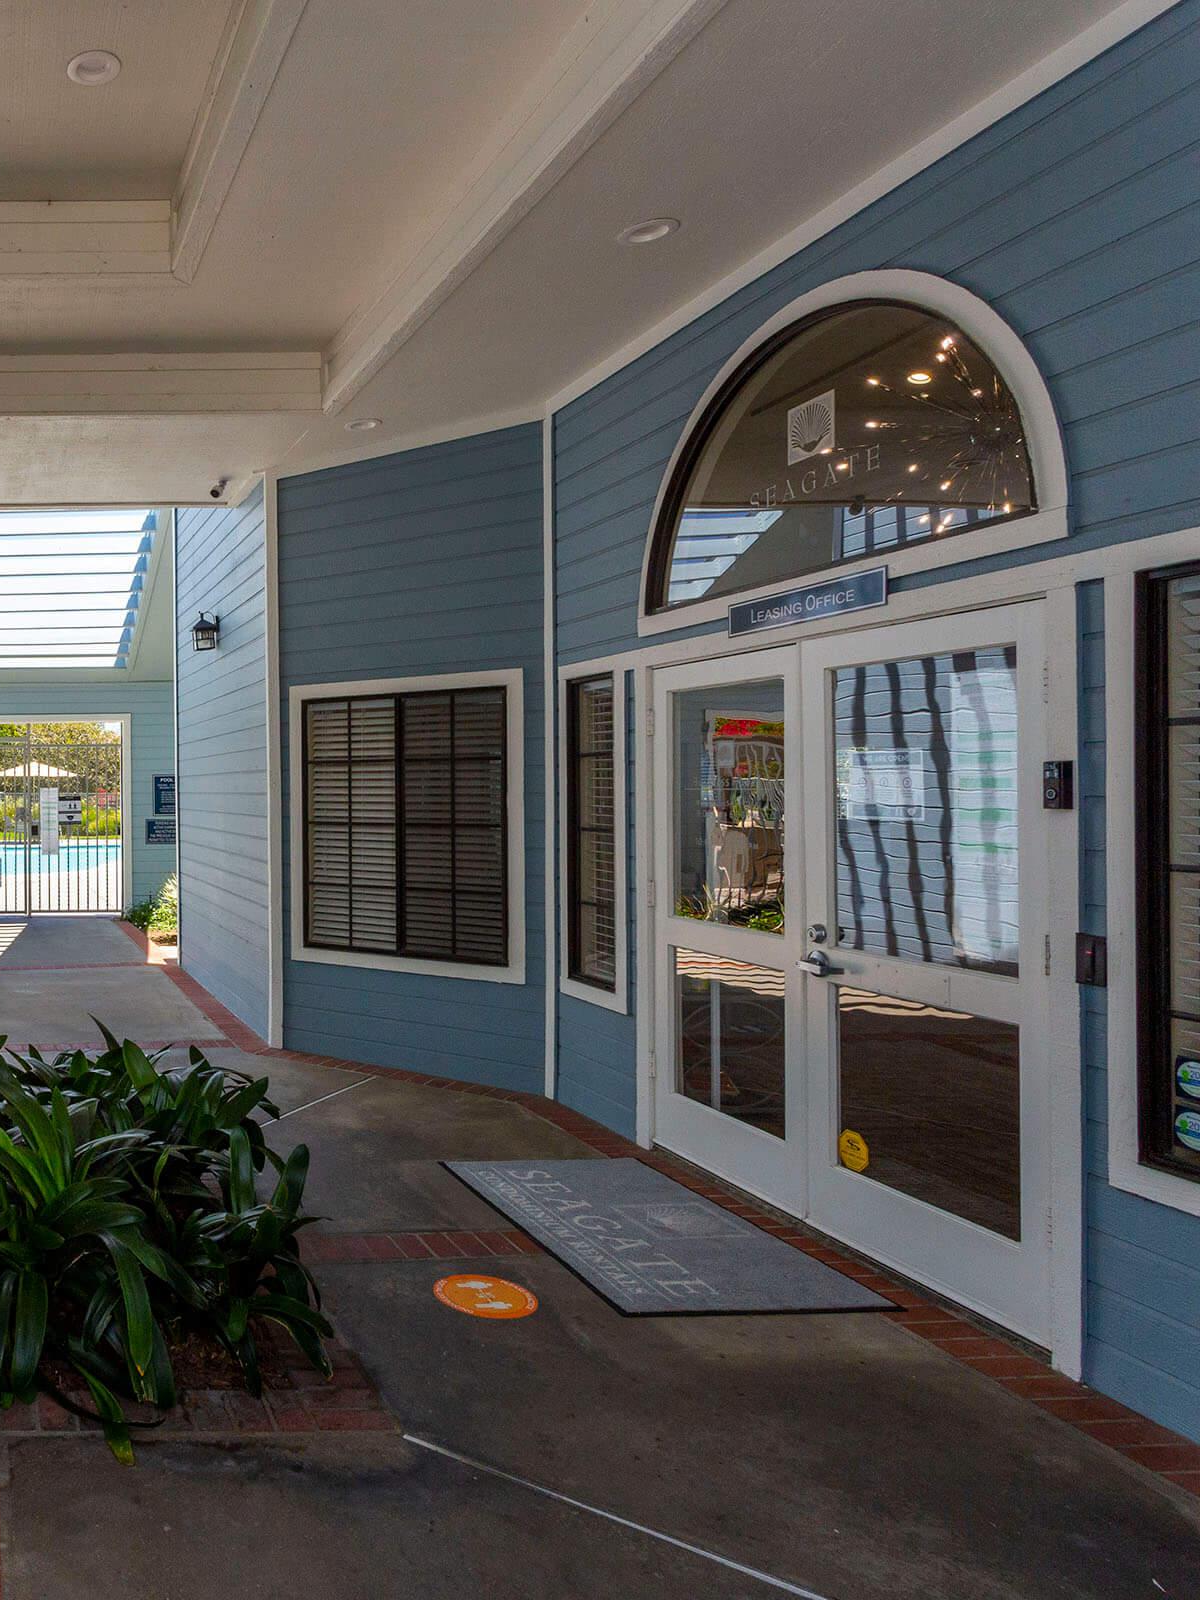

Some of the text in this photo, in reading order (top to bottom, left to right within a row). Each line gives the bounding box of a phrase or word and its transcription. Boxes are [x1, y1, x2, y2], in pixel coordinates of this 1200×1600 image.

[750, 443, 881, 509] SEAGATE
[750, 589, 856, 624] LEASING OFFICE
[507, 1169, 720, 1297] SEAGATE
